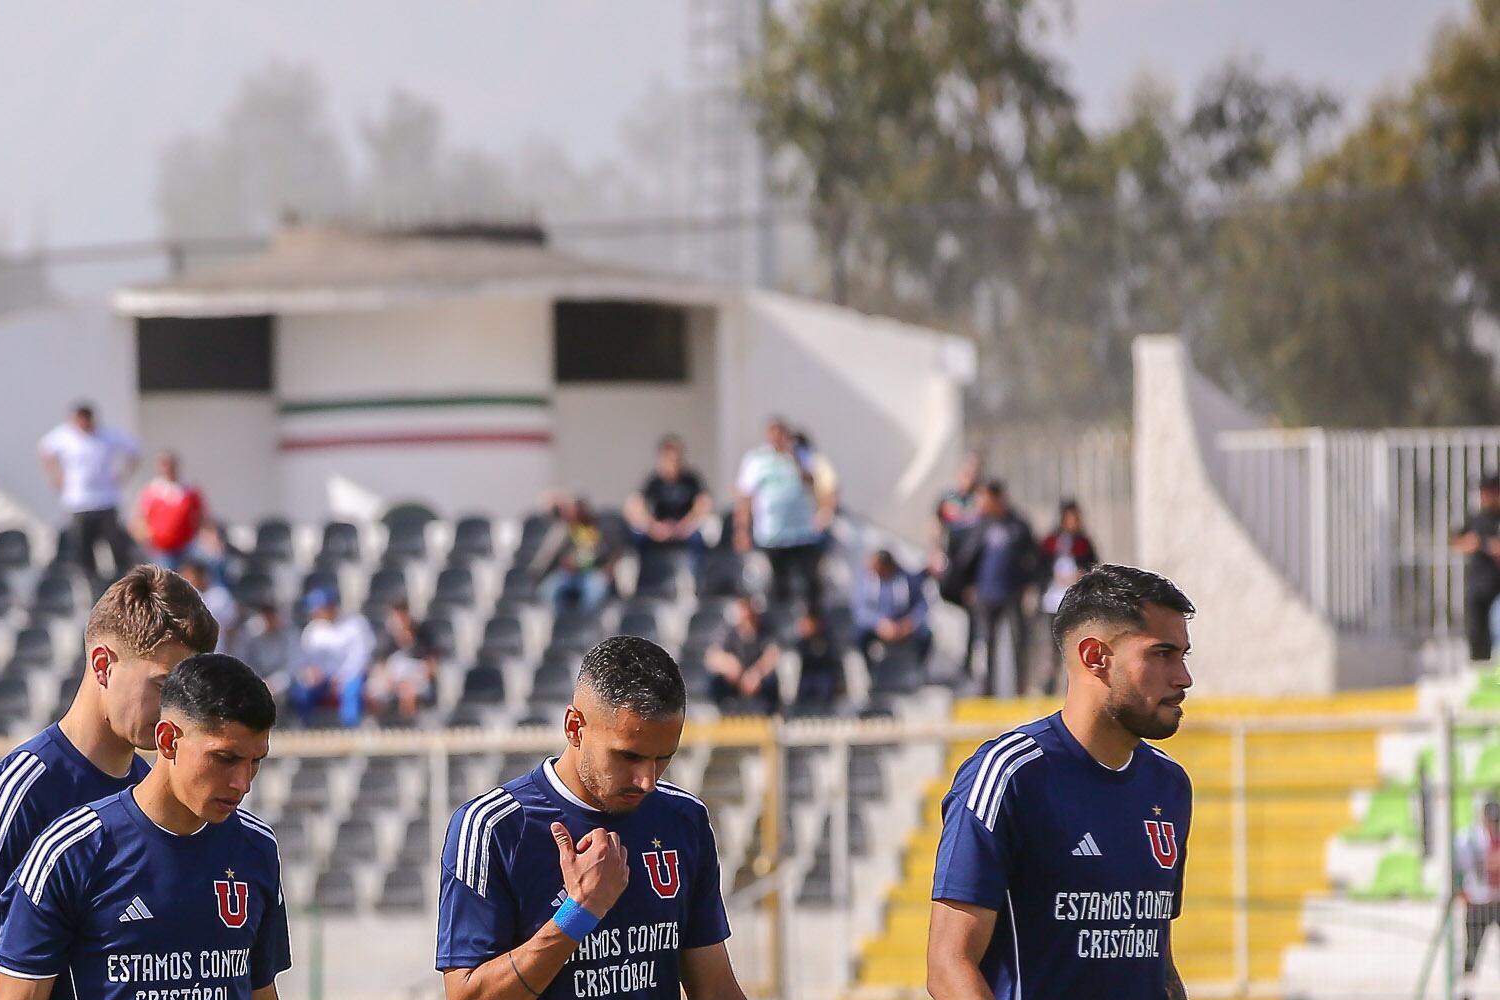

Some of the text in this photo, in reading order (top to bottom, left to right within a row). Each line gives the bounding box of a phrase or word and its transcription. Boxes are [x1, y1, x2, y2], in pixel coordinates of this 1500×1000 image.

[1144, 820, 1177, 869] U
[642, 850, 680, 899] U
[214, 880, 248, 928] U
[1055, 891, 1132, 920] ESTAMOS
[564, 929, 621, 965] AMOS
[1077, 923, 1159, 959] CRISTÓBAL
[108, 951, 192, 982] ESTAMOS
[574, 958, 657, 998] CRISTÓBAL
